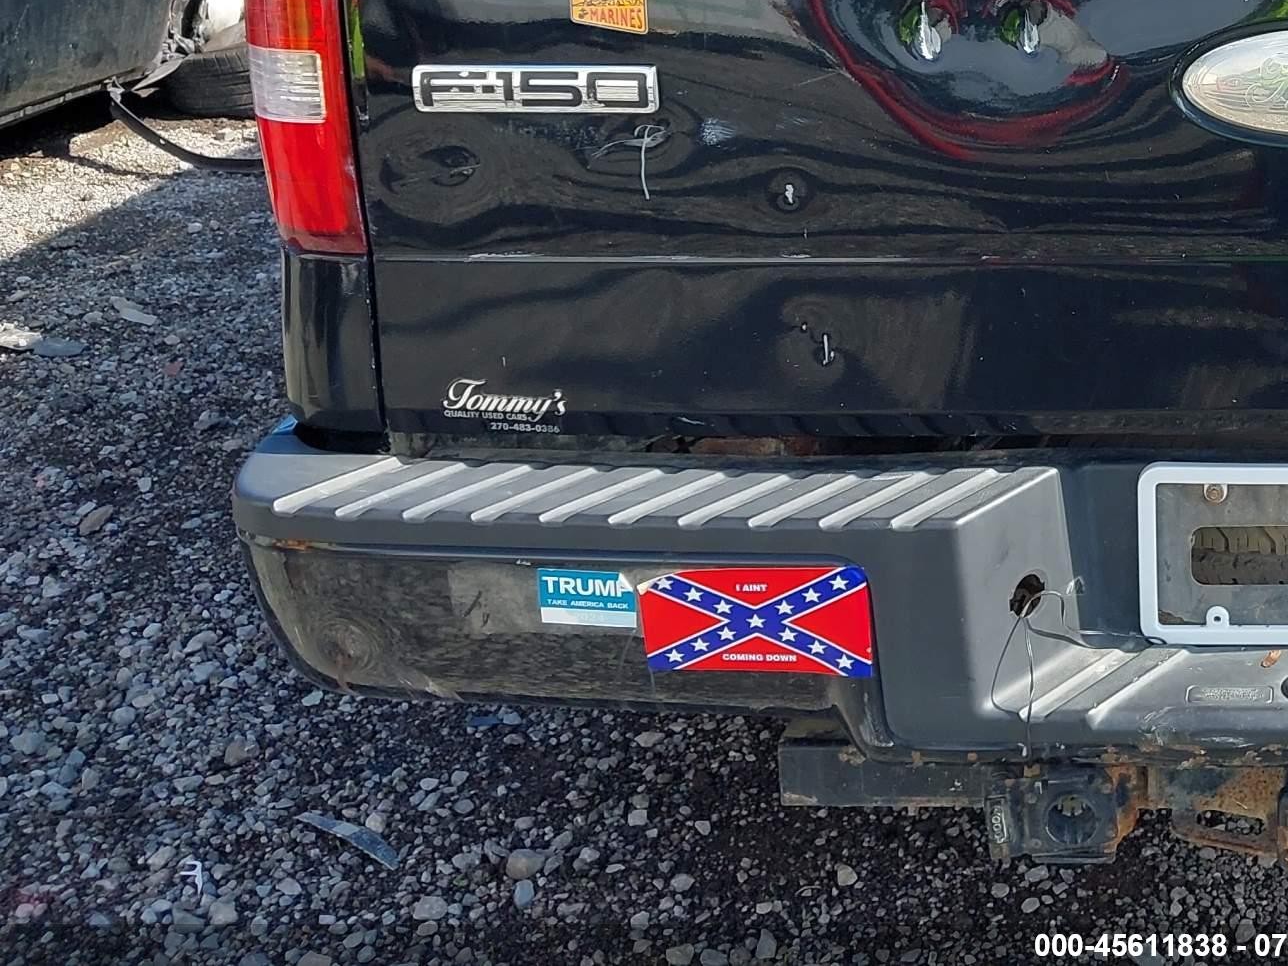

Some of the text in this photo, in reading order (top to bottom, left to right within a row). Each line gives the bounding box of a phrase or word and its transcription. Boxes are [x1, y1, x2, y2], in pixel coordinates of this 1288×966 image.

[590, 7, 643, 29] MARINES
[444, 410, 479, 418] QUALITY
[506, 413, 527, 421] CARS
[743, 583, 768, 592] AINT
[547, 598, 568, 606] TAKE
[570, 600, 604, 608] AMERICA
[722, 652, 797, 662] COMING DOWN
